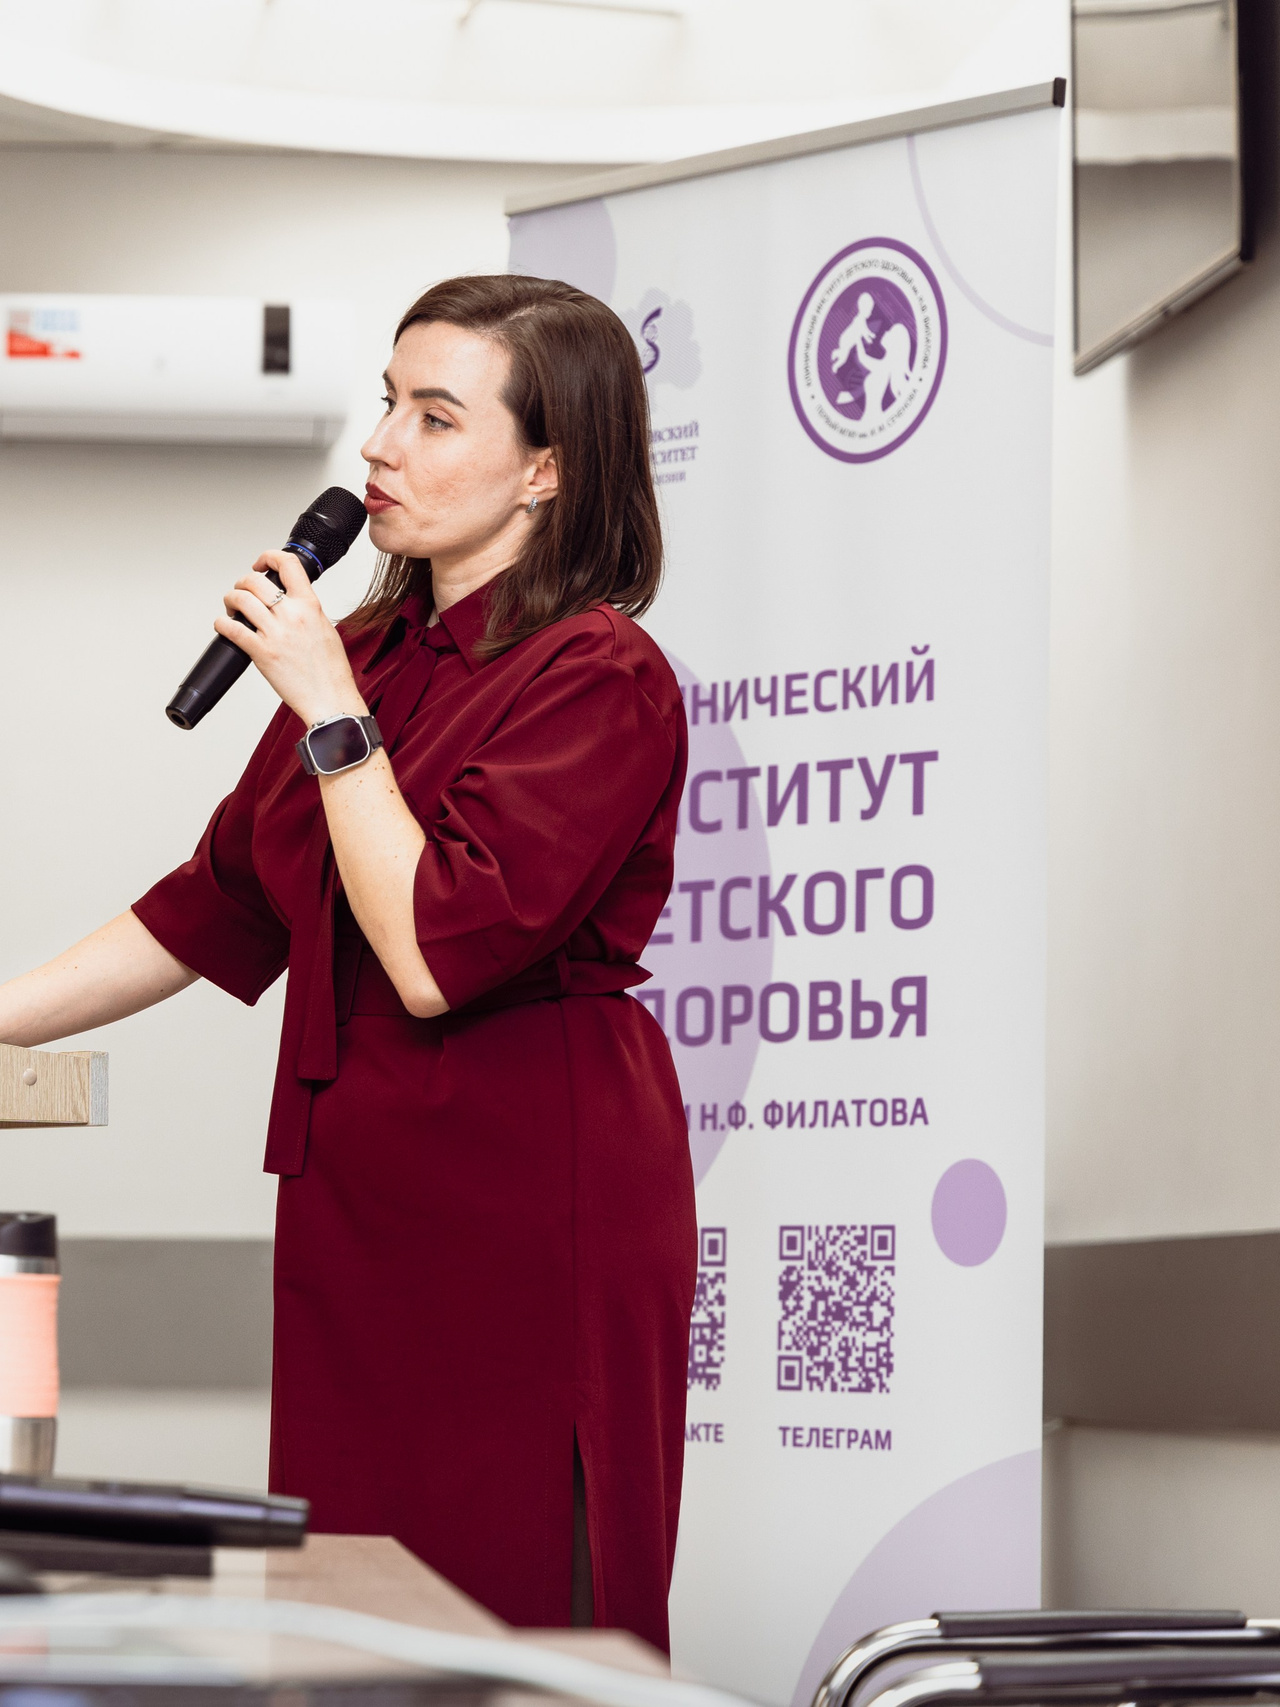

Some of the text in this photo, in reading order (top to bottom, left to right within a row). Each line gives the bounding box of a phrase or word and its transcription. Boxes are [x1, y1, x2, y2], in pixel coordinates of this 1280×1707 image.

[676, 750, 940, 836] СТИТУТ
[762, 1097, 930, 1130] ФИЛАТОВА
[778, 1425, 893, 1451] ТЕЛЕГРАМ
